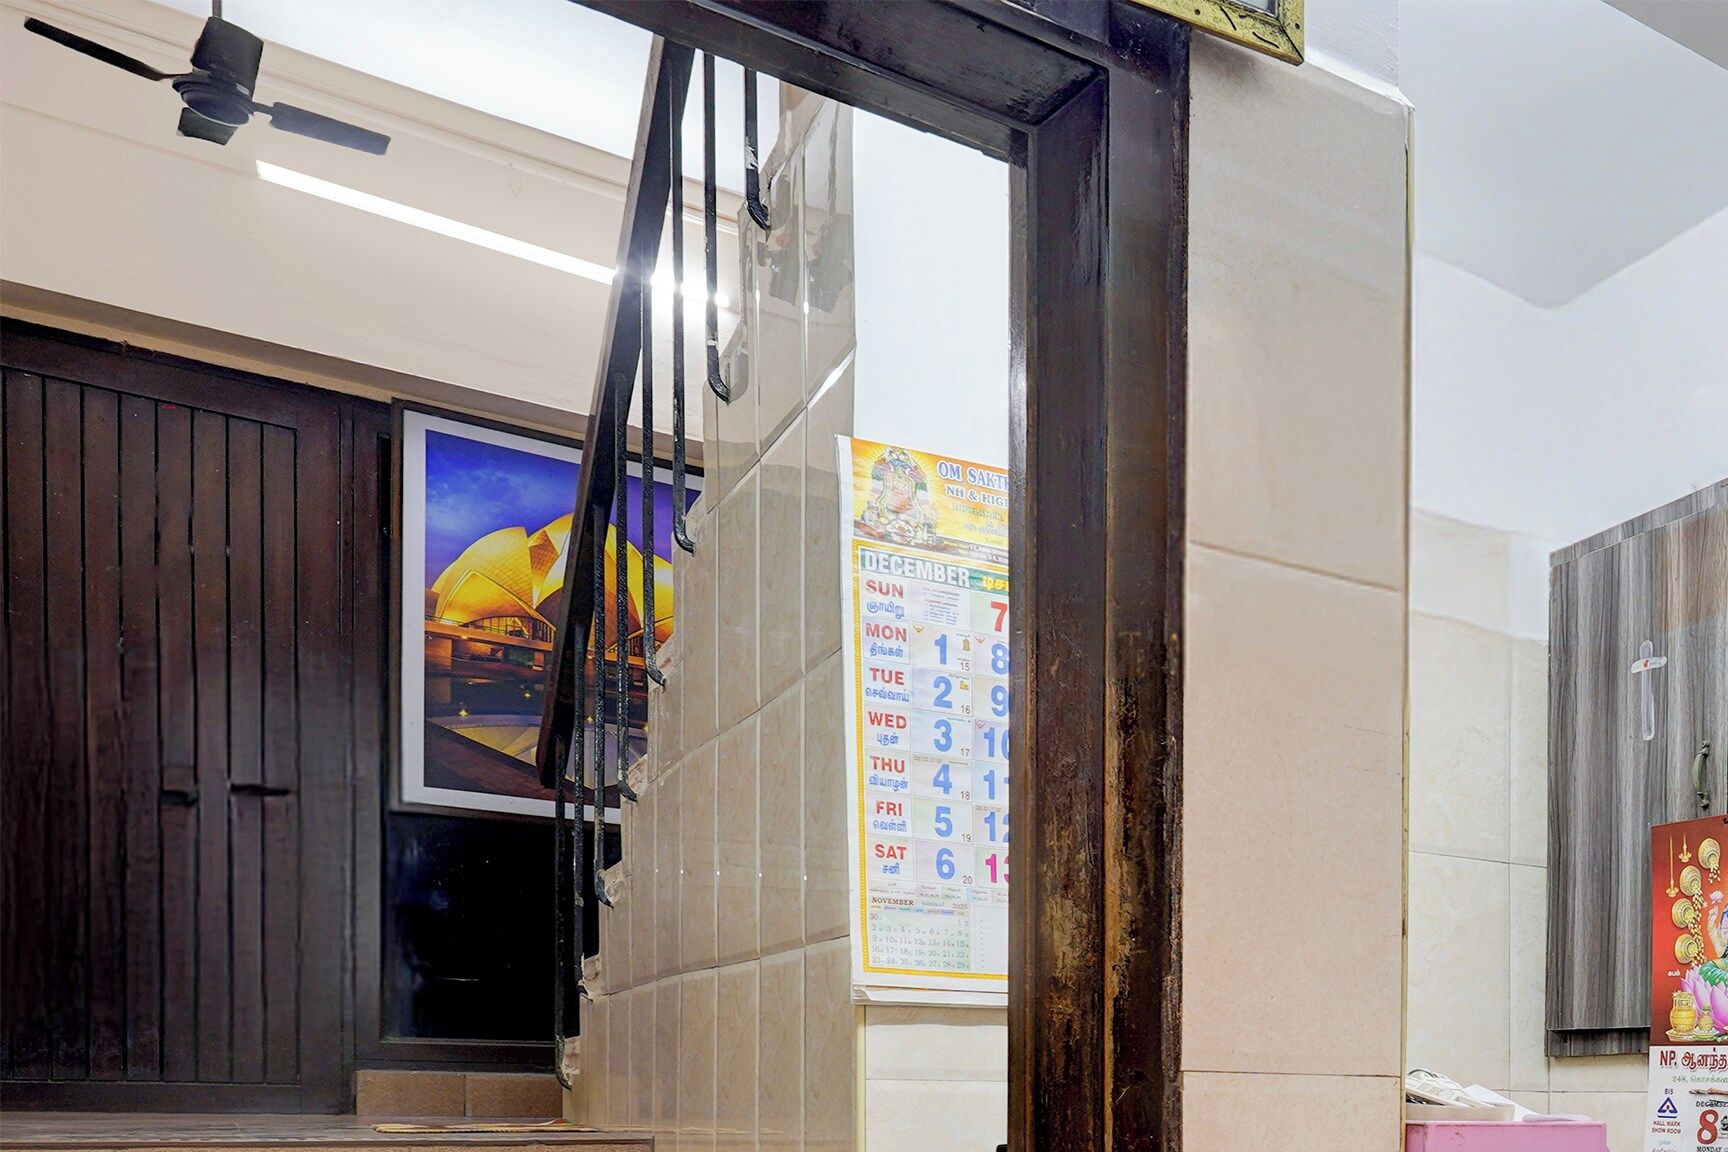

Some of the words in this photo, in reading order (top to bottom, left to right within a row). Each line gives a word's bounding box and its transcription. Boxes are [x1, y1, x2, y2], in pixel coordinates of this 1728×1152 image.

[937, 461, 962, 481] OM
[945, 485, 965, 498] NH
[968, 489, 978, 501] &
[864, 550, 971, 588] DECEMBER
[866, 579, 904, 598] SUN
[990, 601, 1008, 632] 7
[865, 622, 907, 642] MON
[934, 633, 948, 666] 1
[990, 643, 1009, 675] 8
[869, 667, 905, 685] TUE
[960, 662, 971, 672] 15
[933, 676, 952, 709] 2
[990, 685, 1009, 717] 9
[960, 705, 971, 714] 16
[868, 711, 907, 730] WED
[933, 719, 953, 752] 3
[960, 748, 970, 757] 17
[869, 755, 905, 774] THU
[932, 763, 953, 795] 4
[983, 769, 1009, 800] 1
[960, 791, 971, 800] 18
[875, 800, 903, 817] FRI
[934, 806, 953, 838] 5
[962, 833, 972, 842] 19
[874, 844, 907, 860] SAT
[936, 847, 956, 880] 6
[962, 875, 973, 884] 20
[872, 897, 914, 906] NOVEMBER
[1660, 1050, 1677, 1067] NP.
[1697, 1109, 1719, 1145] 8
